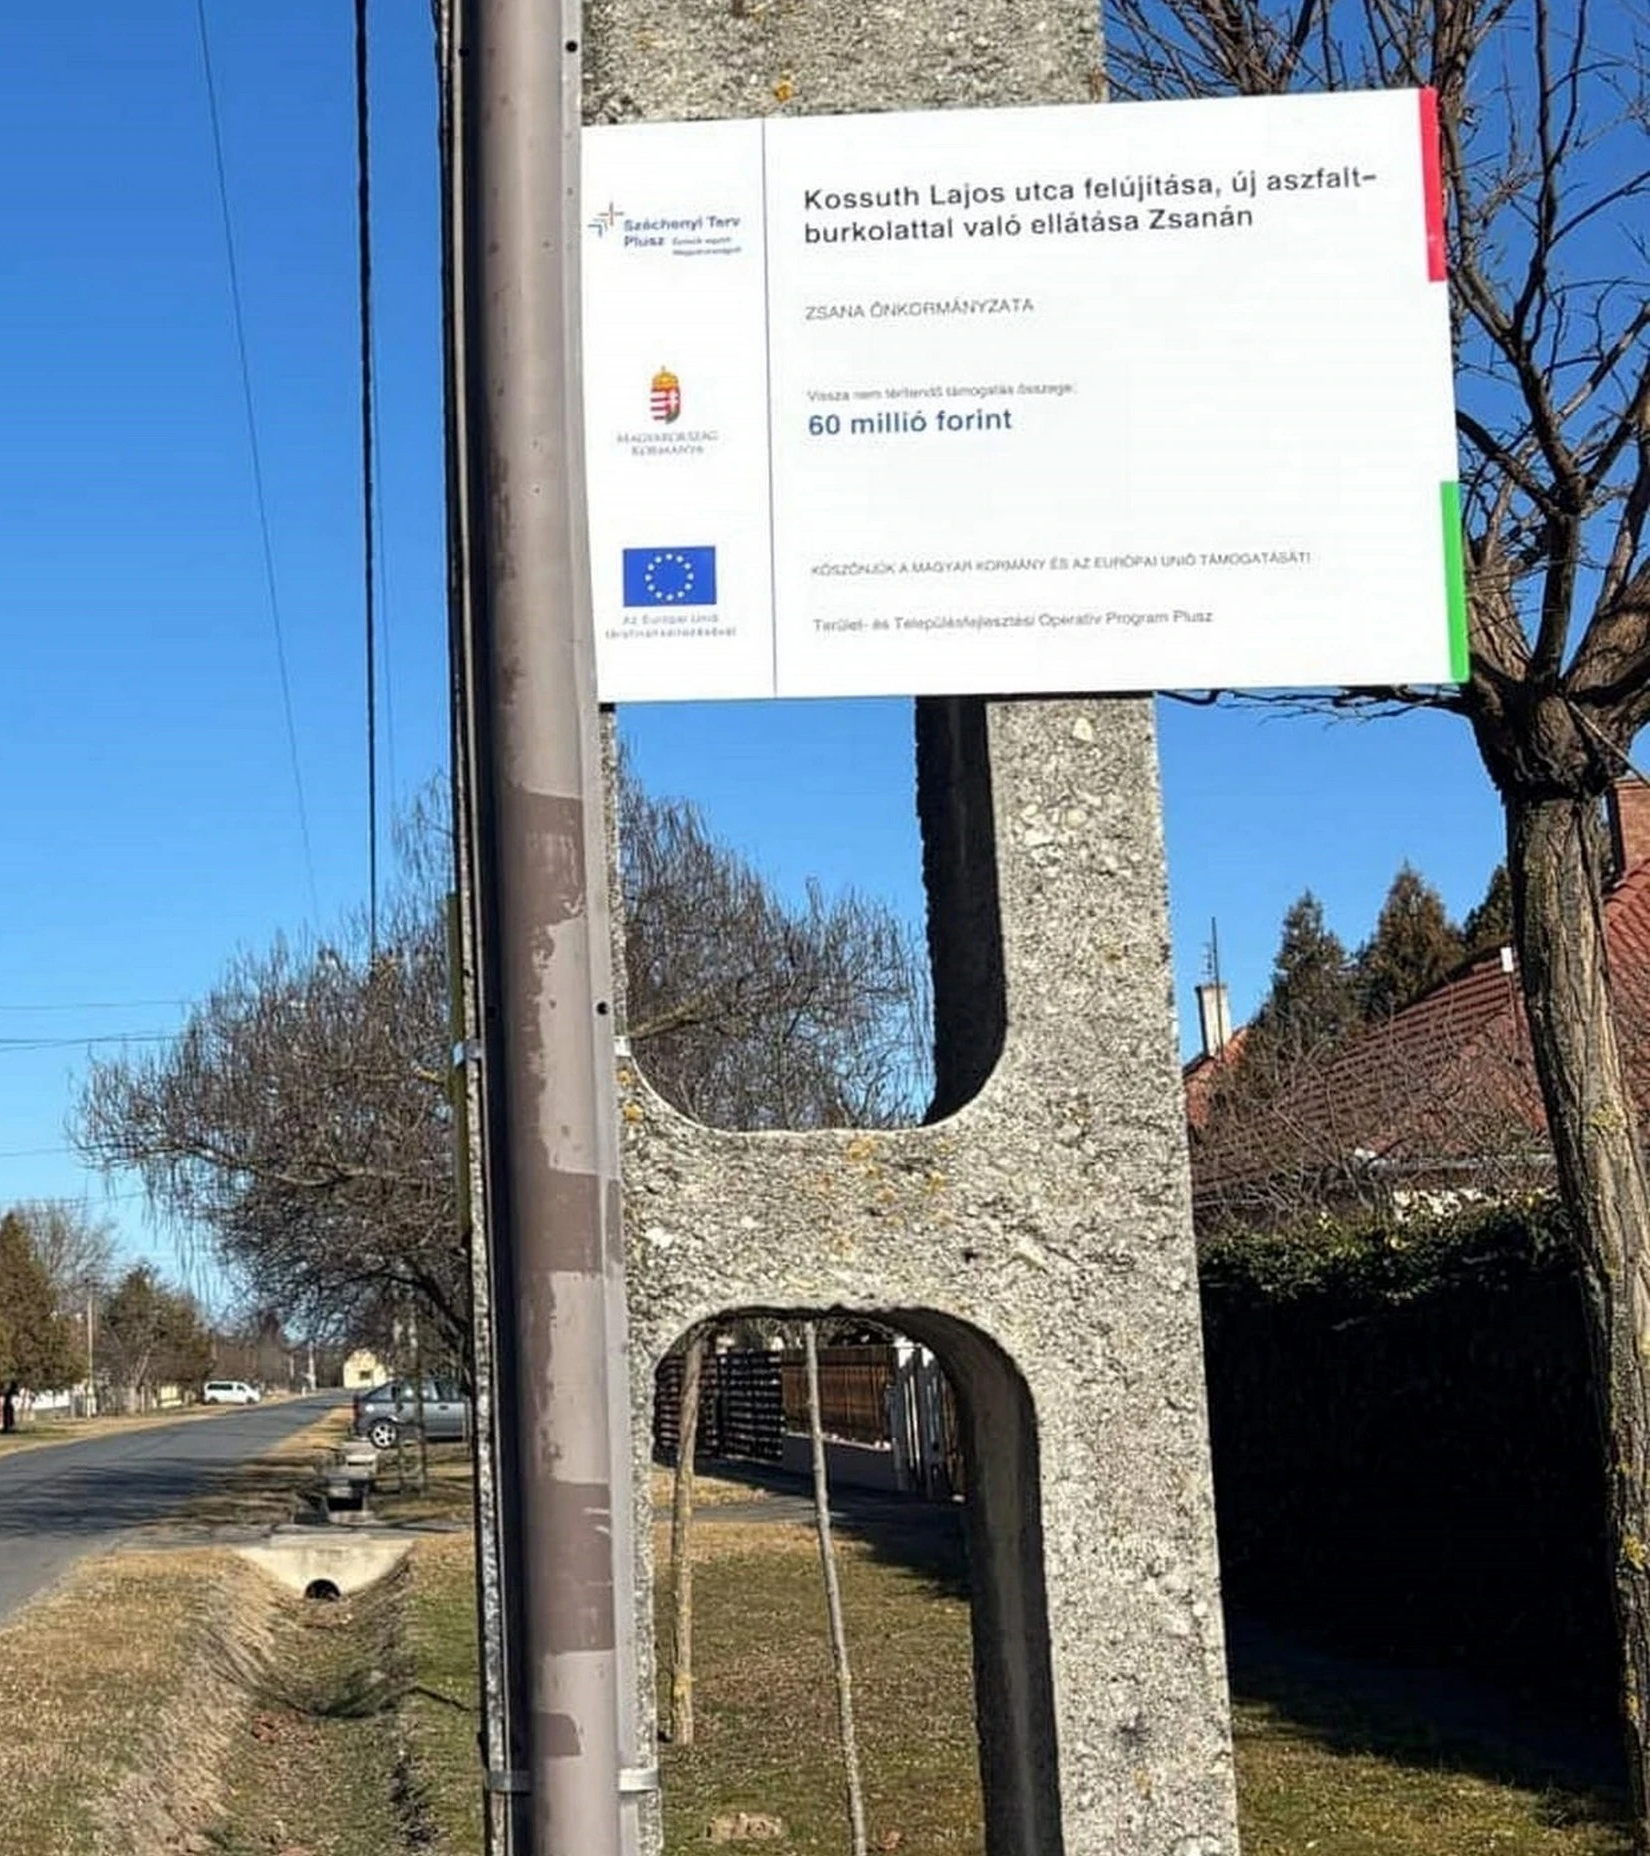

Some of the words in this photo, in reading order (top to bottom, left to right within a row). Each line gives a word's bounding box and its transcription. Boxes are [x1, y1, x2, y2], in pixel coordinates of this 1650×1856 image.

[804, 186, 920, 210] Kossuth
[930, 184, 1005, 209] Lajos
[1015, 182, 1075, 202] utca
[1084, 173, 1222, 202] felújítása,
[1231, 170, 1256, 198] új
[804, 217, 953, 243] burkolattal
[963, 214, 1021, 237] való
[1030, 208, 1139, 234] ellátása
[1148, 205, 1253, 230] Zsanán
[623, 236, 665, 248] Plusz
[805, 305, 865, 320] ZSANA
[869, 296, 1034, 318] ÖNKORMÁNYZATA
[806, 389, 850, 402] Vissza
[853, 390, 882, 400] nem
[808, 414, 841, 436] 60
[850, 409, 927, 435] millió
[936, 408, 1012, 431] forint
[899, 563, 909, 574] A
[911, 559, 973, 573] MAGYAR
[1073, 557, 1091, 569] AZ
[872, 618, 889, 630] és
[1105, 610, 1169, 627] Program
[1173, 609, 1214, 623] Plusz
